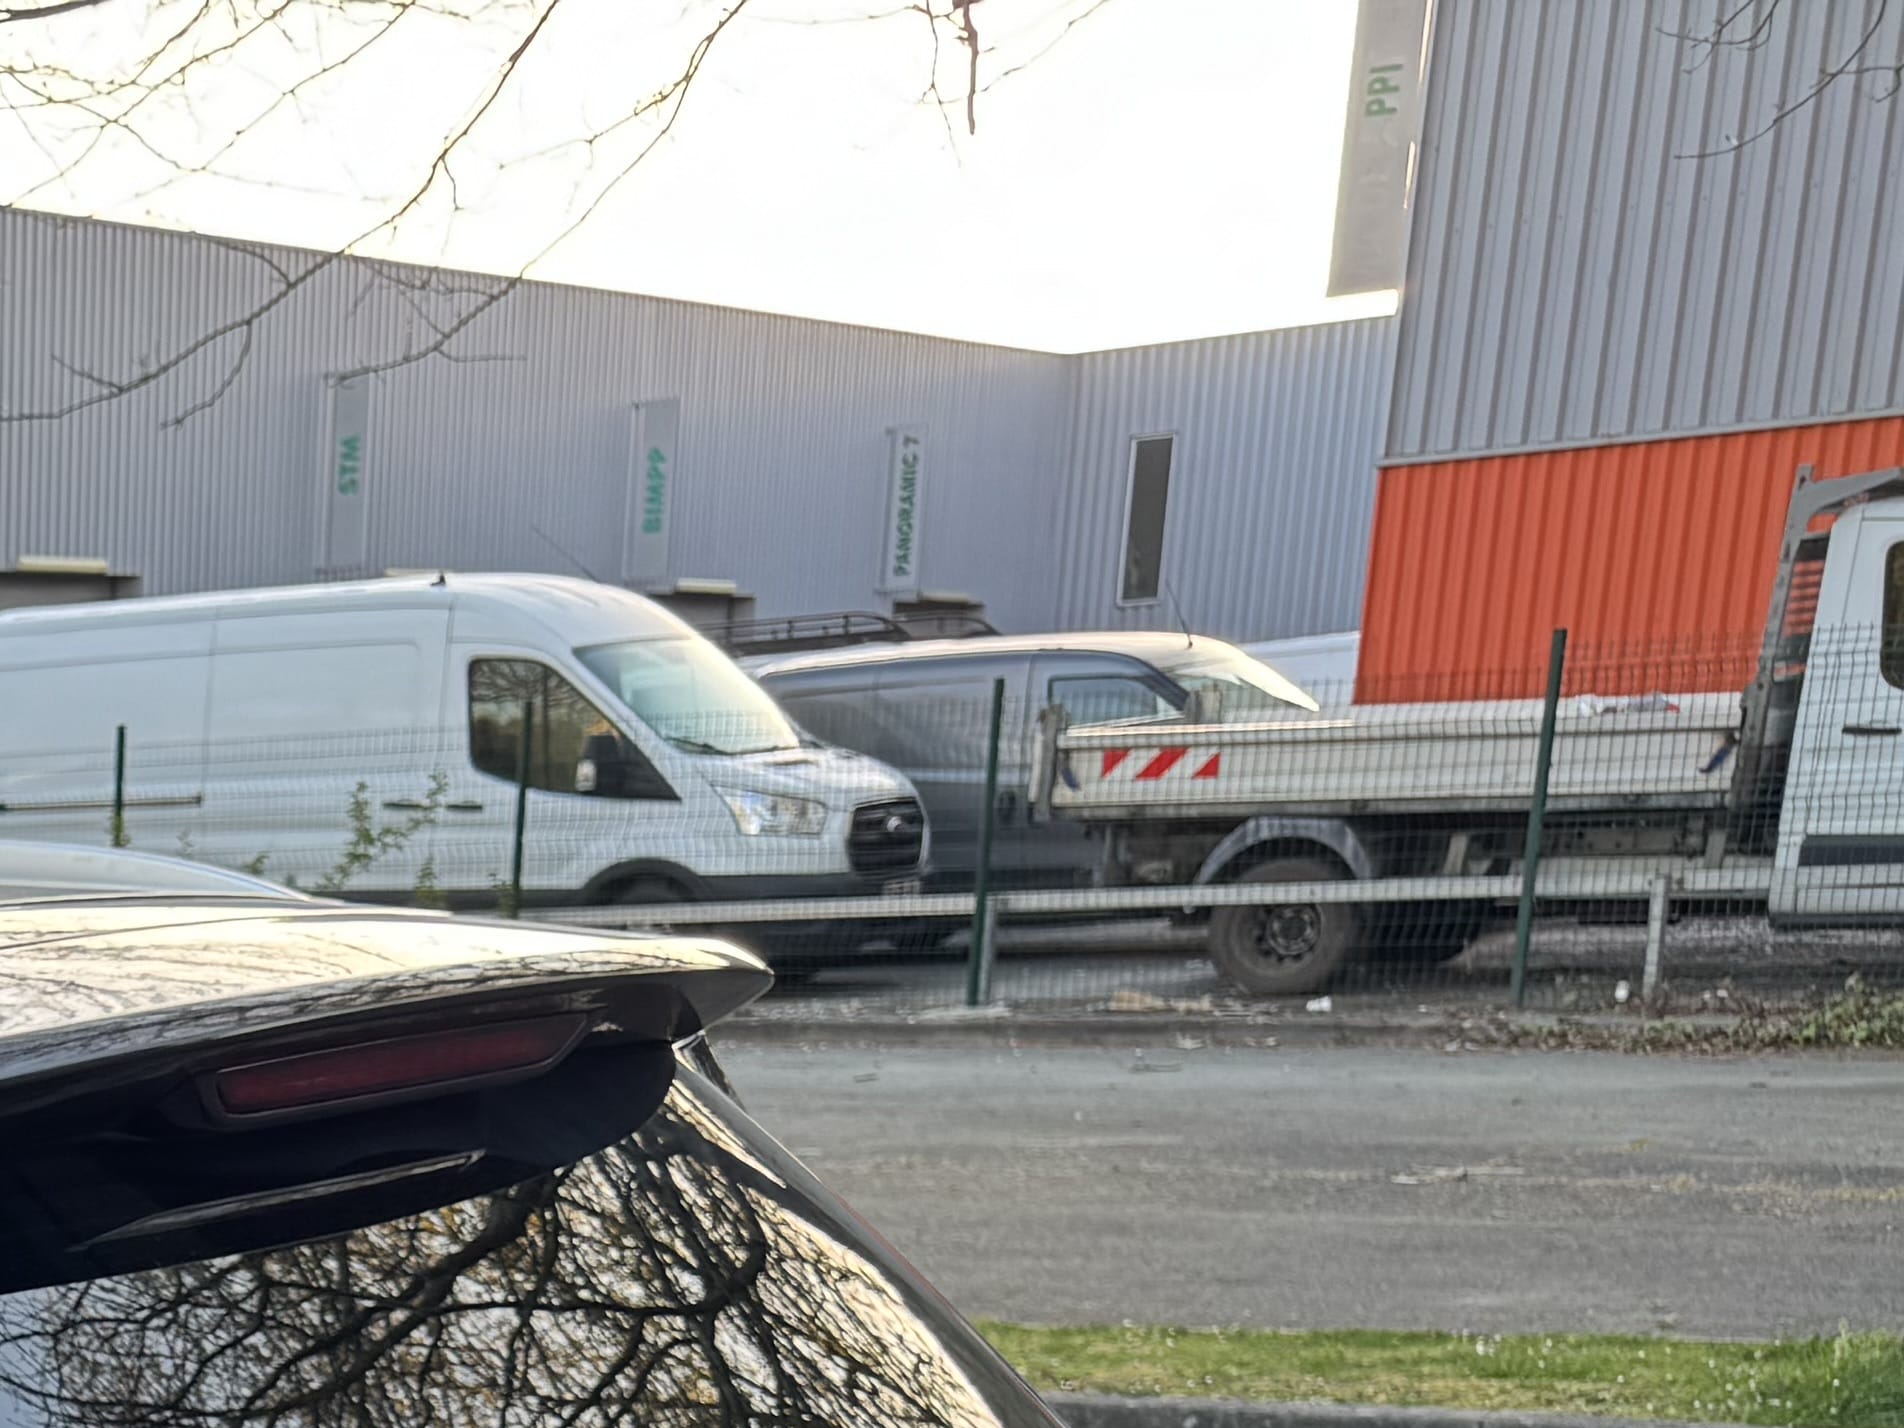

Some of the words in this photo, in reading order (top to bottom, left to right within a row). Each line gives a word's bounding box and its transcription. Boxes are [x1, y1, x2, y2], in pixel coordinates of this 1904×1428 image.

[1364, 63, 1403, 117] PPI
[338, 434, 361, 496] STM
[892, 453, 919, 577] PANORAMIC
